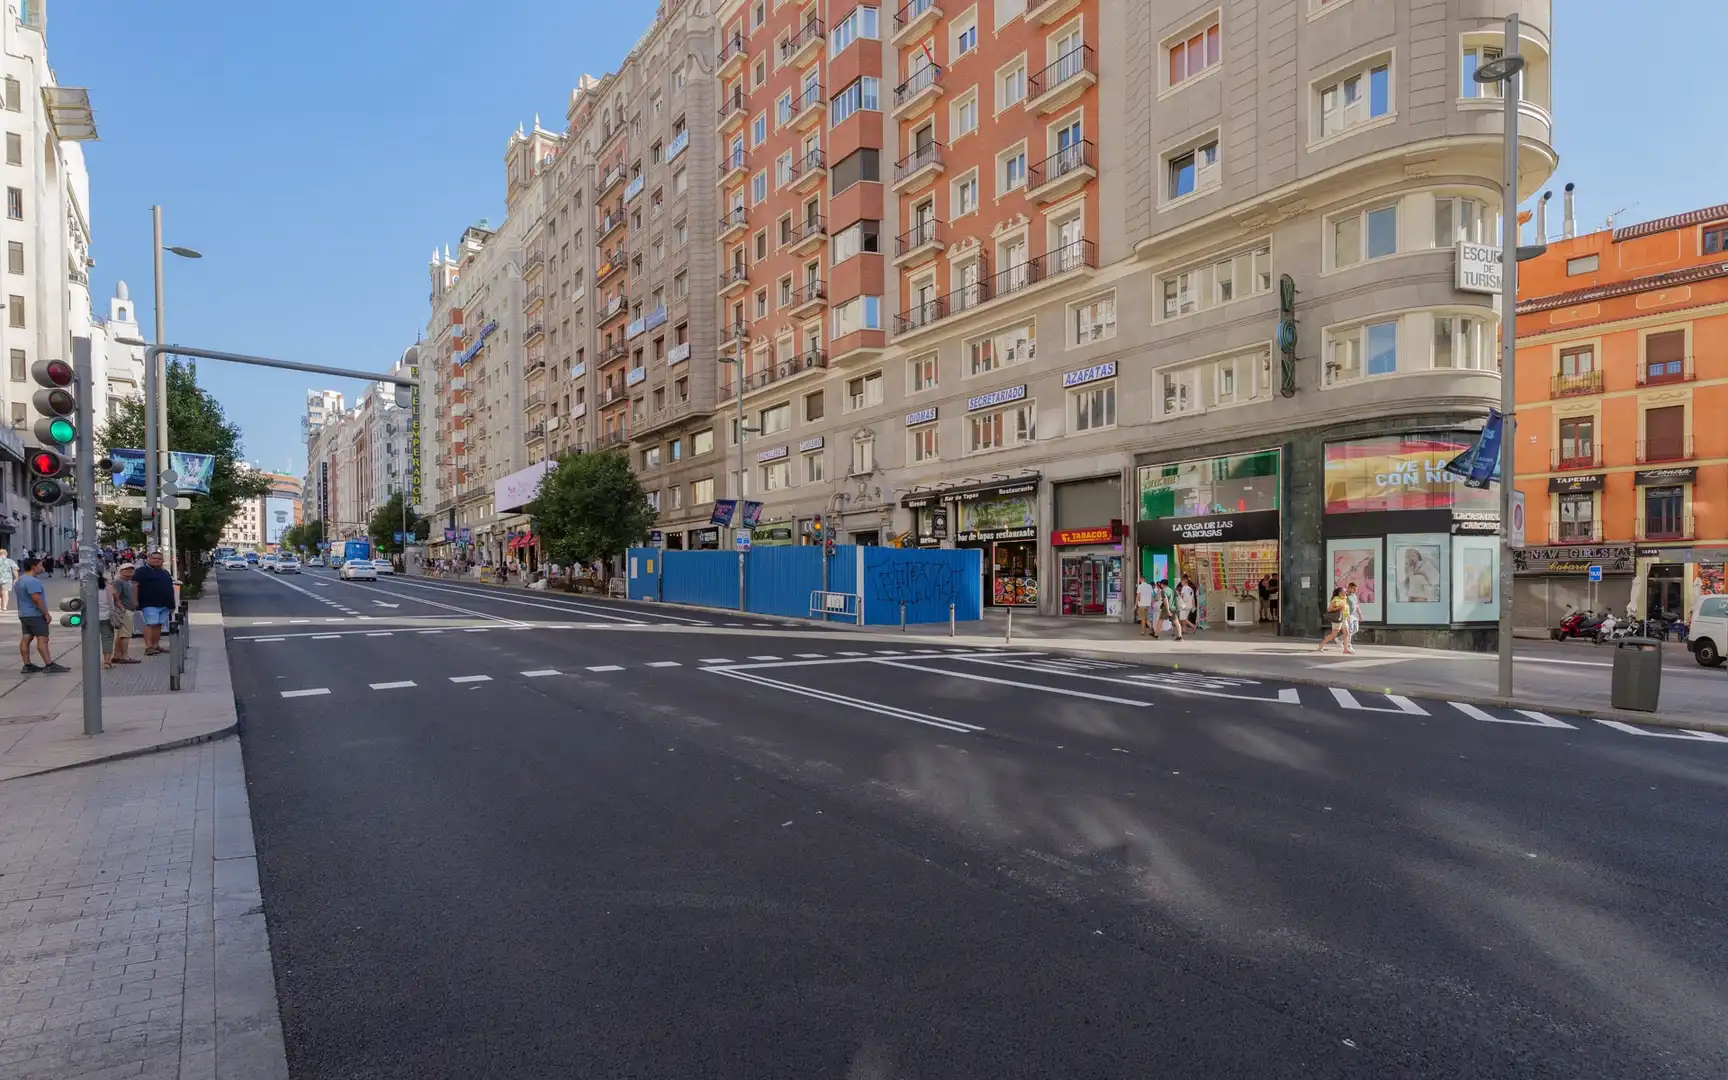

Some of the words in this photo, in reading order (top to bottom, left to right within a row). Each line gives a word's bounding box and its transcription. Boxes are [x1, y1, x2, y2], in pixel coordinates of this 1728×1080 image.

[1463, 246, 1502, 264] ESCUE
[1483, 264, 1494, 274] DE
[1463, 271, 1502, 289] TURISM
[1065, 363, 1114, 385] AZAFATAS
[411, 366, 420, 414] HTEL
[969, 386, 1024, 409] SECRETARIADO
[906, 410, 935, 424] IDIOMAS
[412, 420, 420, 505] EMPERADOR
[1396, 460, 1418, 472] VE
[1375, 472, 1418, 486] CON
[1556, 475, 1596, 484] TAPERIA
[999, 486, 1033, 495] Restaurante
[1172, 524, 1183, 532] LA
[1184, 522, 1203, 531] CASA
[1204, 521, 1215, 530] DE
[1216, 520, 1233, 529] LAS
[958, 533, 967, 542] bar
[968, 532, 976, 541] de
[977, 531, 994, 542] tapas
[996, 528, 1035, 539] restaurante
[1071, 531, 1108, 540] TABACOS
[1182, 529, 1223, 538] CARCASAS
[1530, 549, 1558, 559] NEW
[1569, 548, 1608, 558] GIRLS
[1548, 561, 1591, 572] Cabaret
